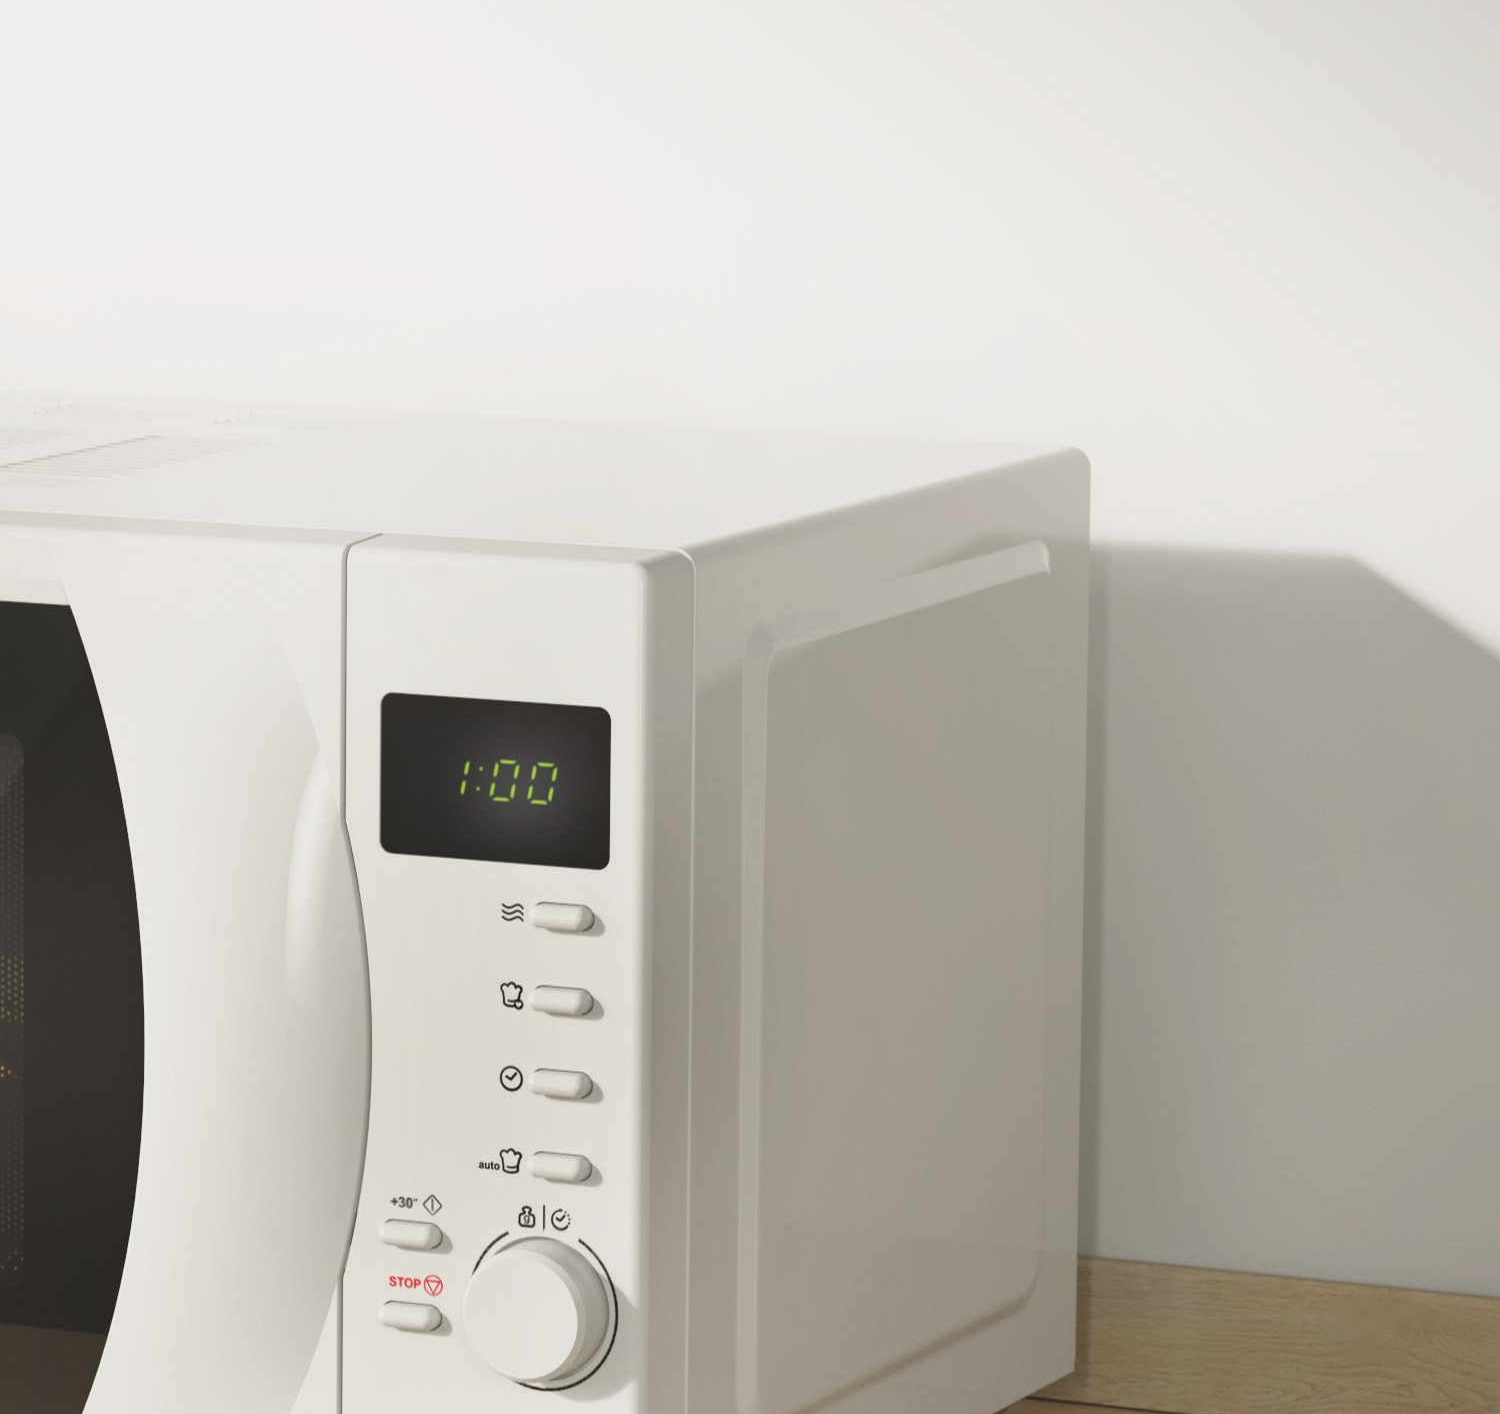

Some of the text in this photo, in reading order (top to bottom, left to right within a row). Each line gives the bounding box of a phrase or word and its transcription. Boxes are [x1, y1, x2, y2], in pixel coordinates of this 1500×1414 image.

[460, 759, 558, 805] 1:00
[478, 1161, 501, 1171] auto
[389, 1275, 421, 1289] STOP
